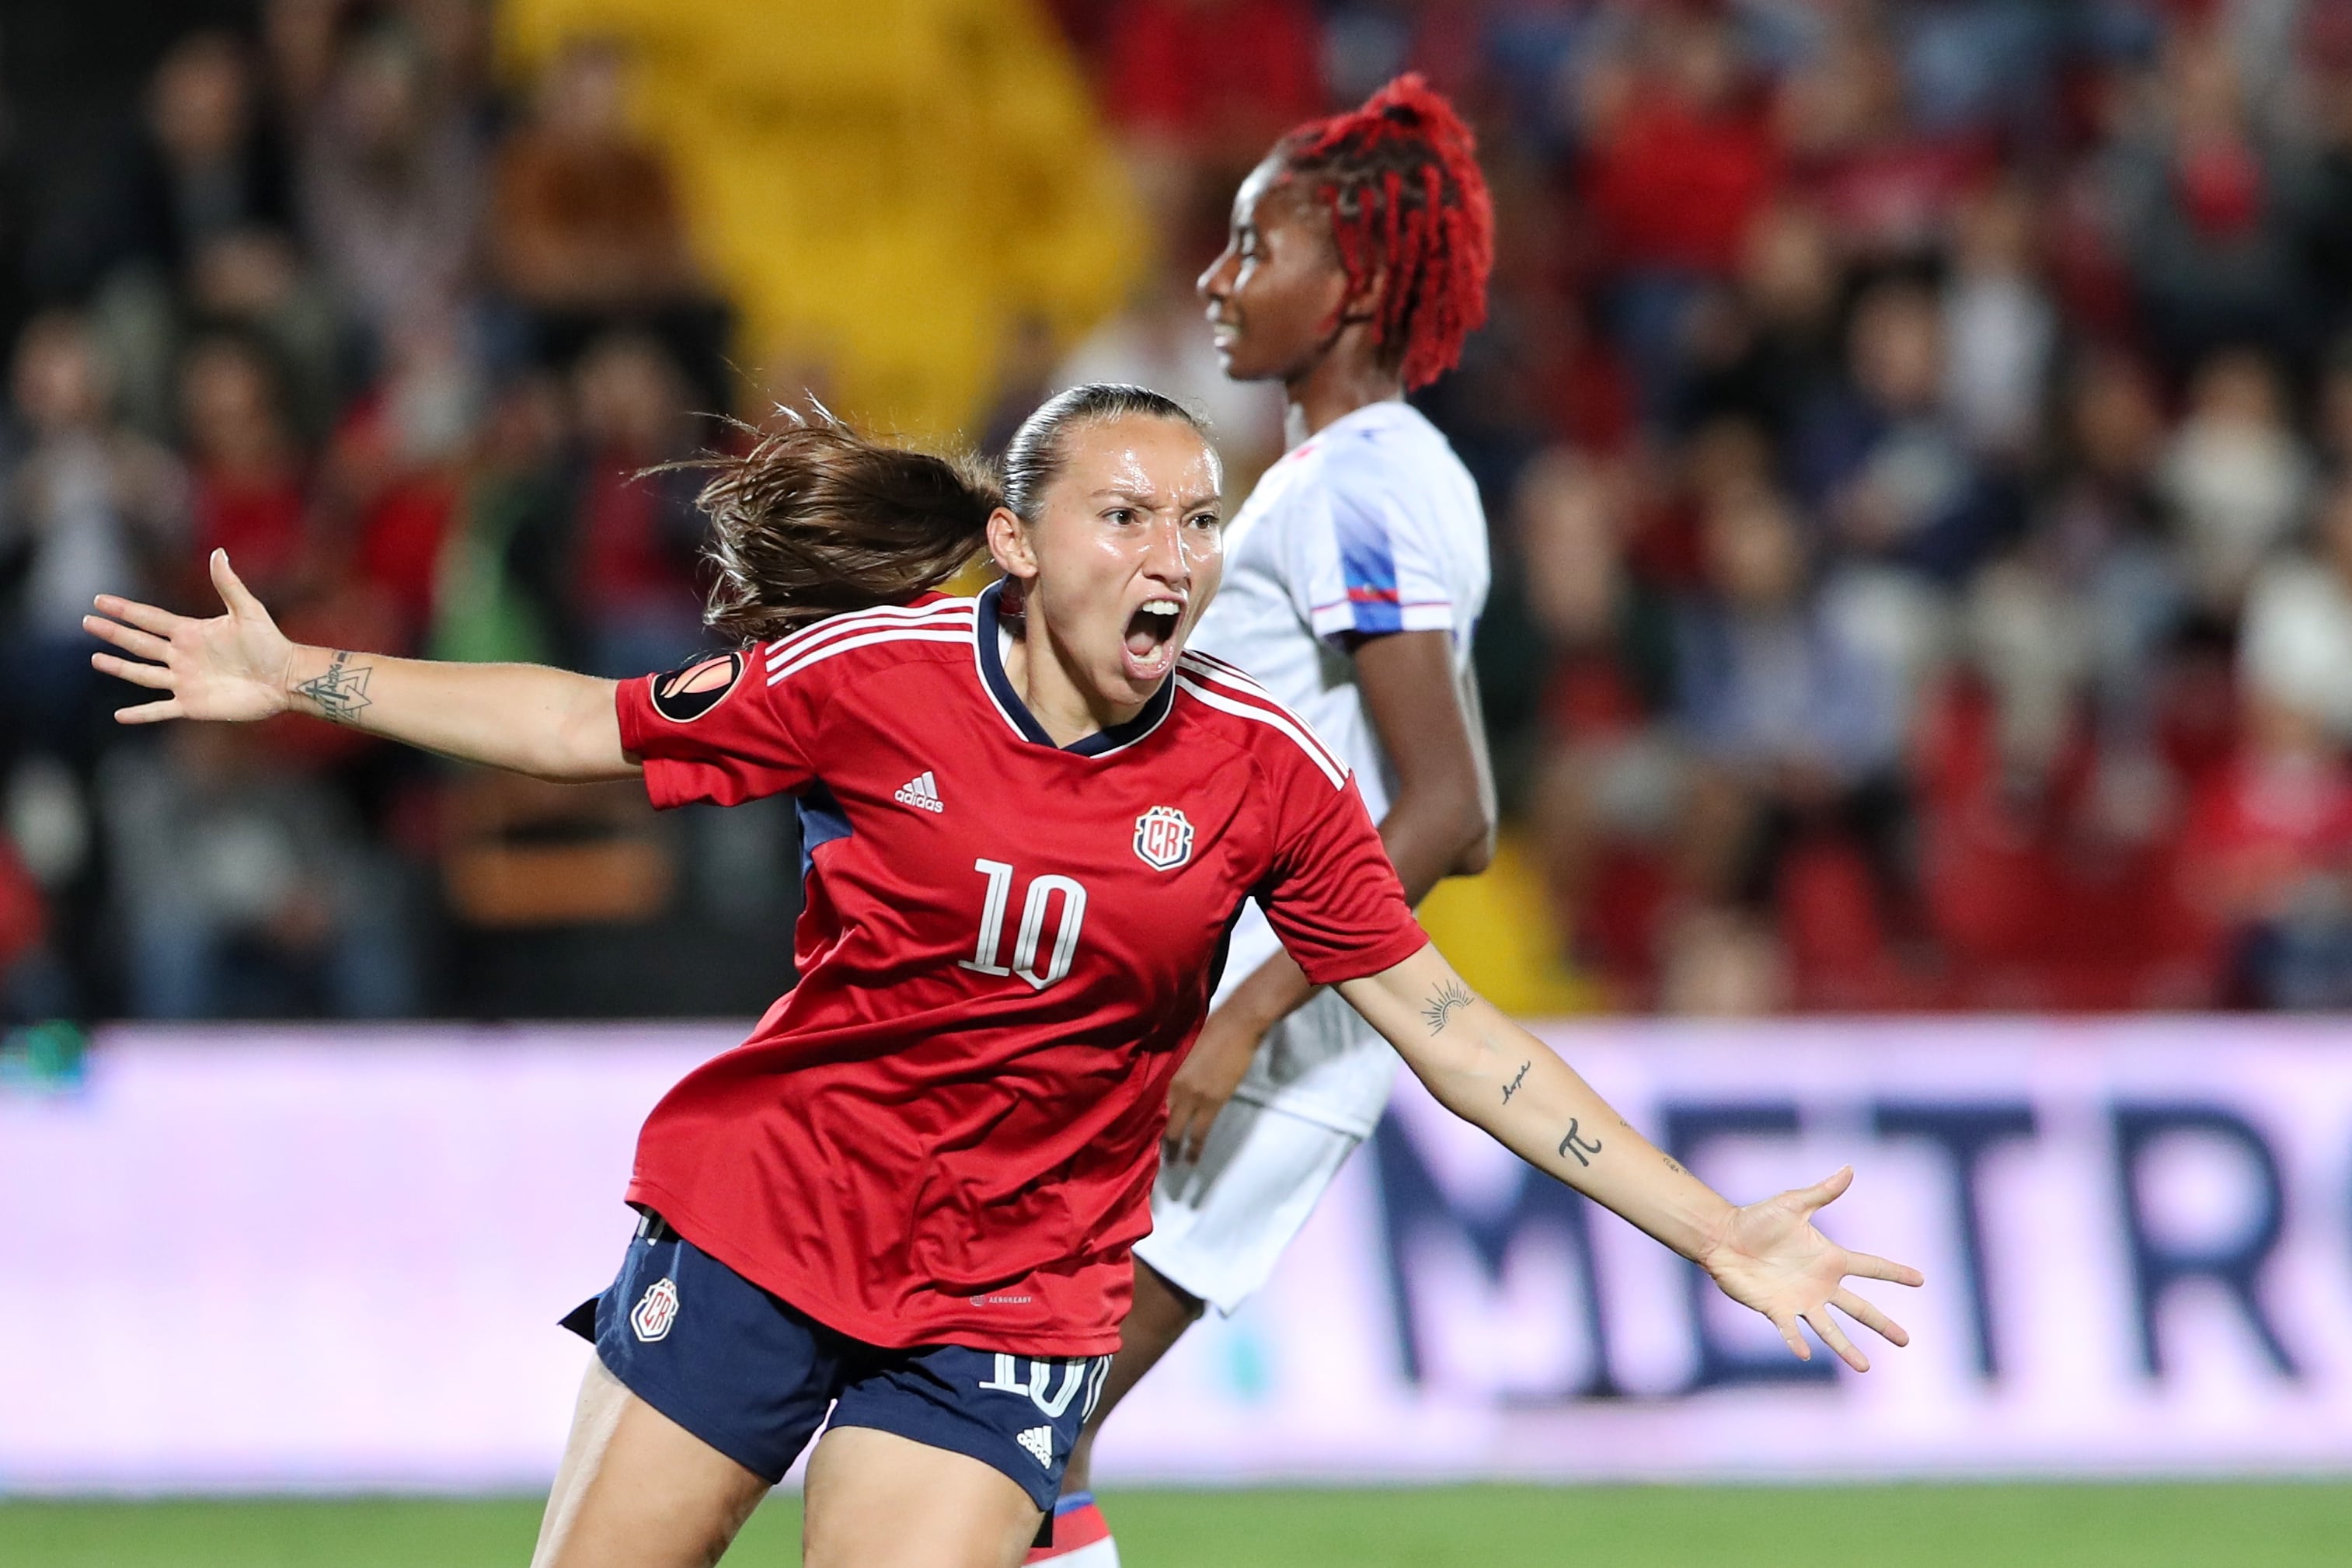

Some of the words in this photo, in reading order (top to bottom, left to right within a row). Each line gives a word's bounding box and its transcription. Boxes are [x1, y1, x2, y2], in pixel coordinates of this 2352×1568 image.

[894, 789, 945, 814] adidas
[1148, 820, 1180, 859] CR
[958, 858, 1088, 990] 10
[1502, 1060, 1531, 1105] hope
[1371, 1103, 2352, 1396] METR
[643, 1291, 671, 1331] CR
